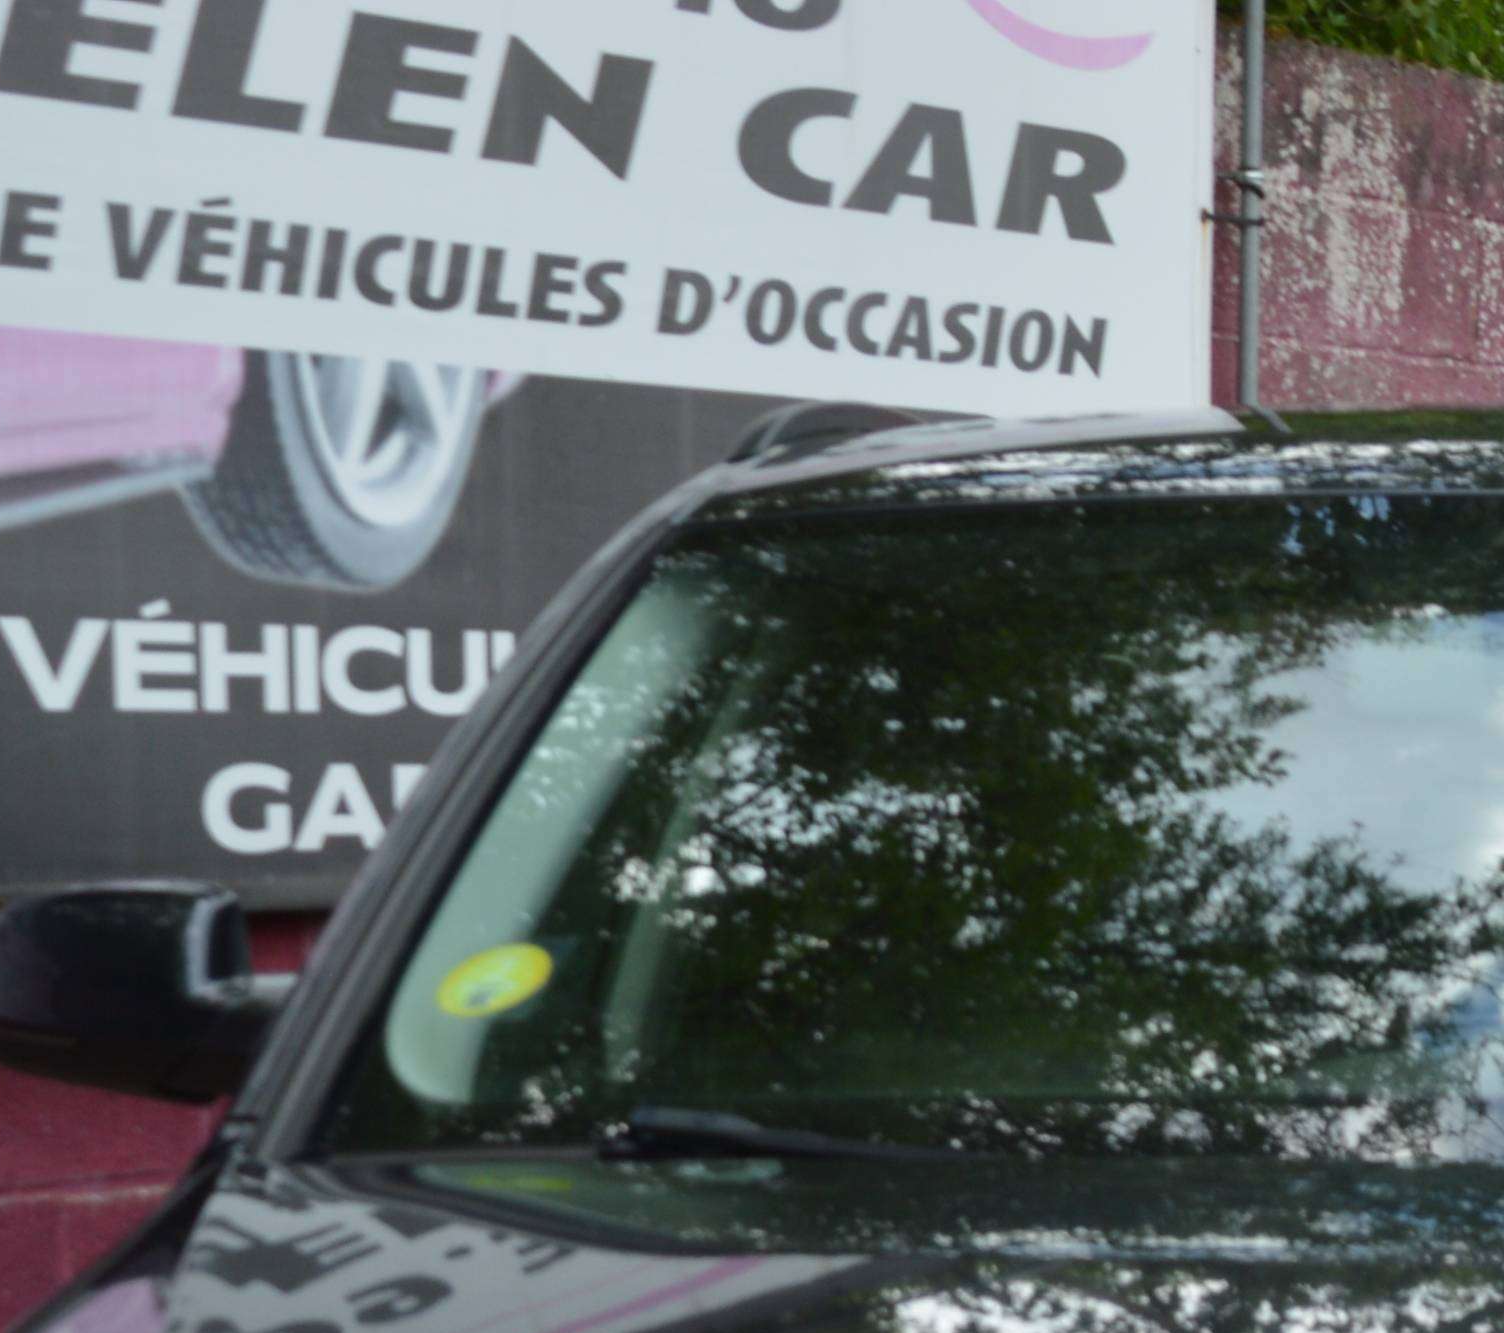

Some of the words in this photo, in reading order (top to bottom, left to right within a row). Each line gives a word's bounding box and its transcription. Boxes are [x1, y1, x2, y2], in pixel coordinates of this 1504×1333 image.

[737, 87, 1127, 244] CAR
[106, 198, 627, 328] VÉHICULES
[656, 268, 1108, 376] D'OCCASION
